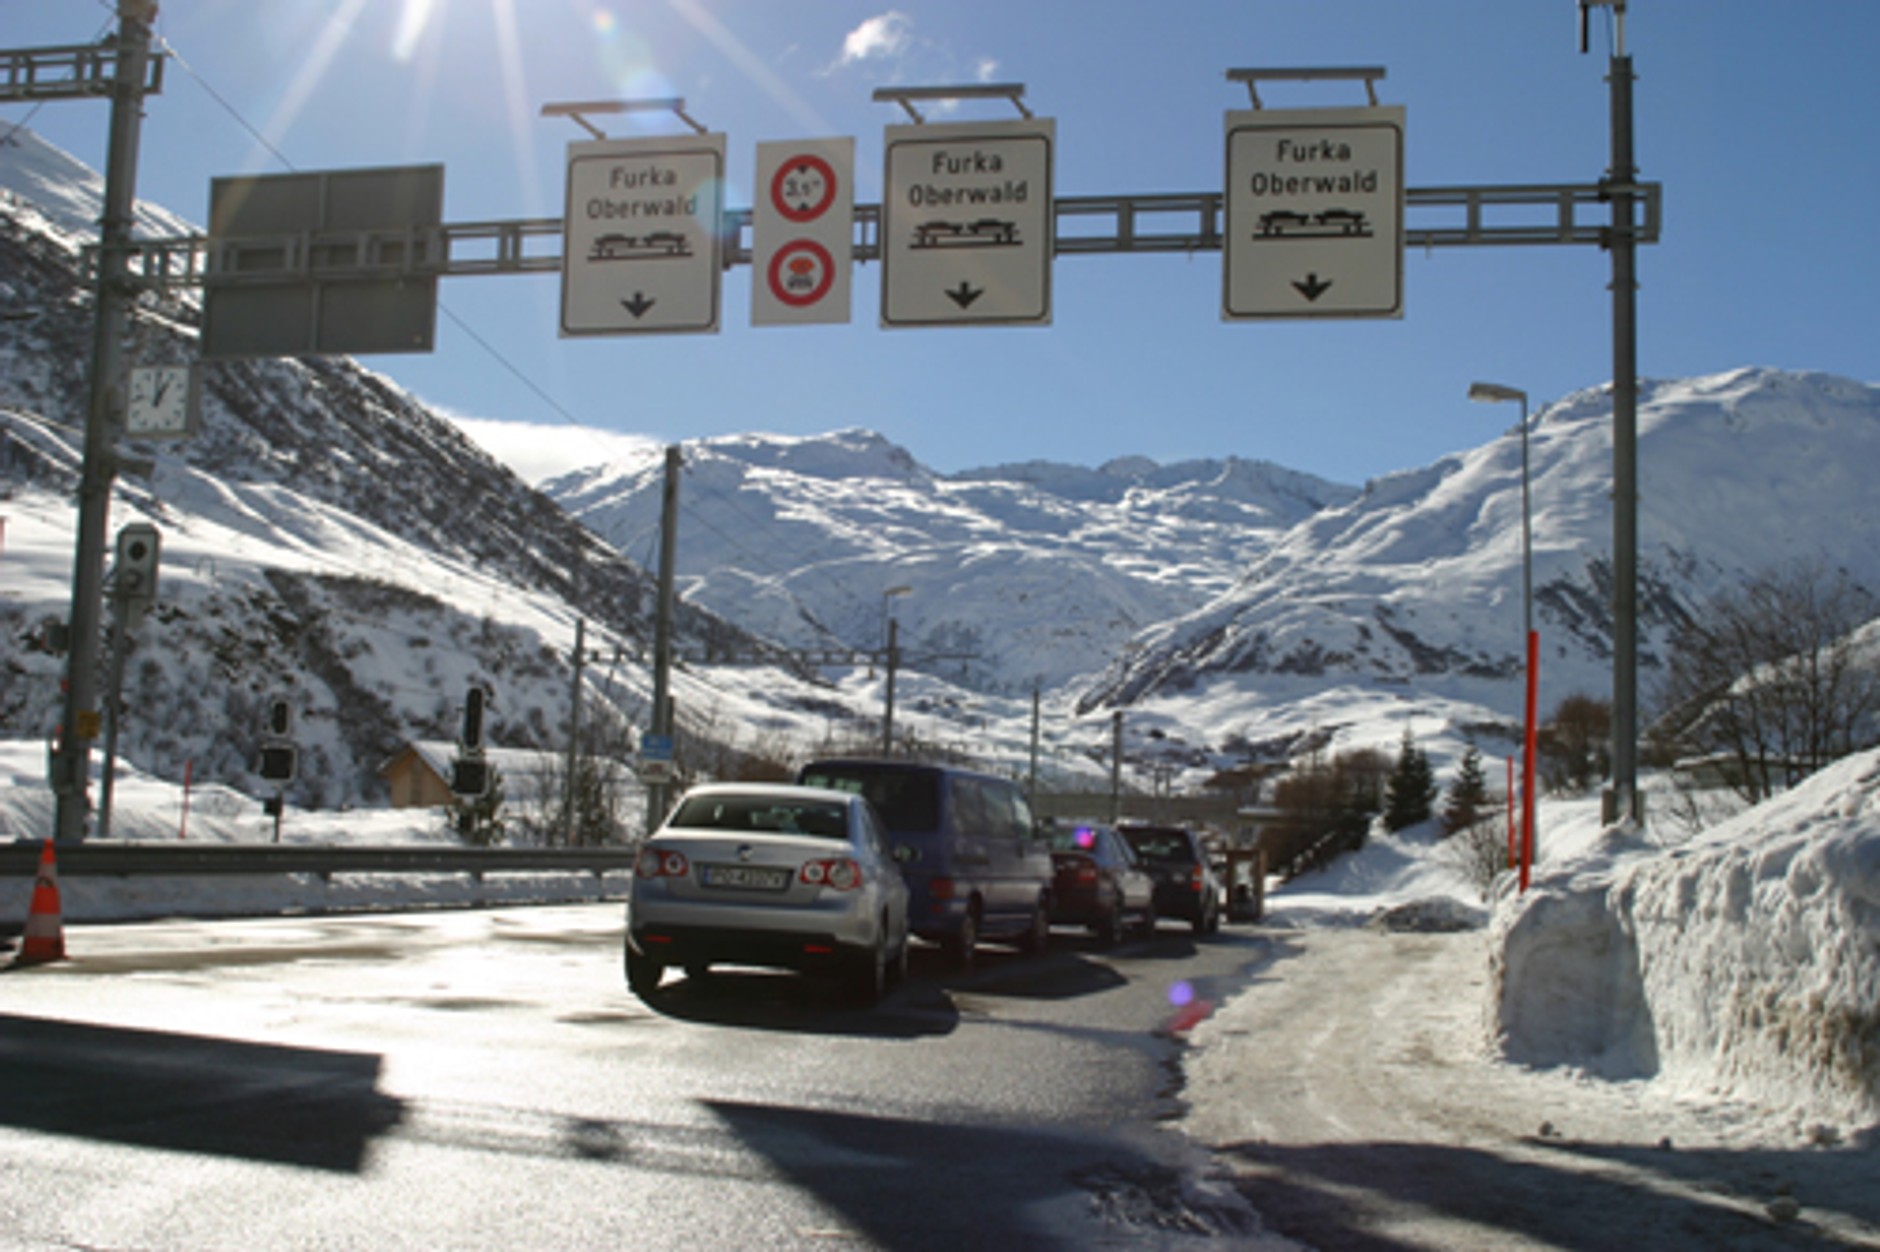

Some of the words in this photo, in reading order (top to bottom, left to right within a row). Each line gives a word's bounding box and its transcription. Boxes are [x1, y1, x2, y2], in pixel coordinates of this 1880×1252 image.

[932, 150, 1003, 175] Furka
[1276, 139, 1351, 163] Furka
[610, 165, 677, 189] Furka
[1251, 170, 1378, 197] Oberwald
[586, 194, 698, 220] Oberwald
[909, 180, 1029, 209] Oberwald
